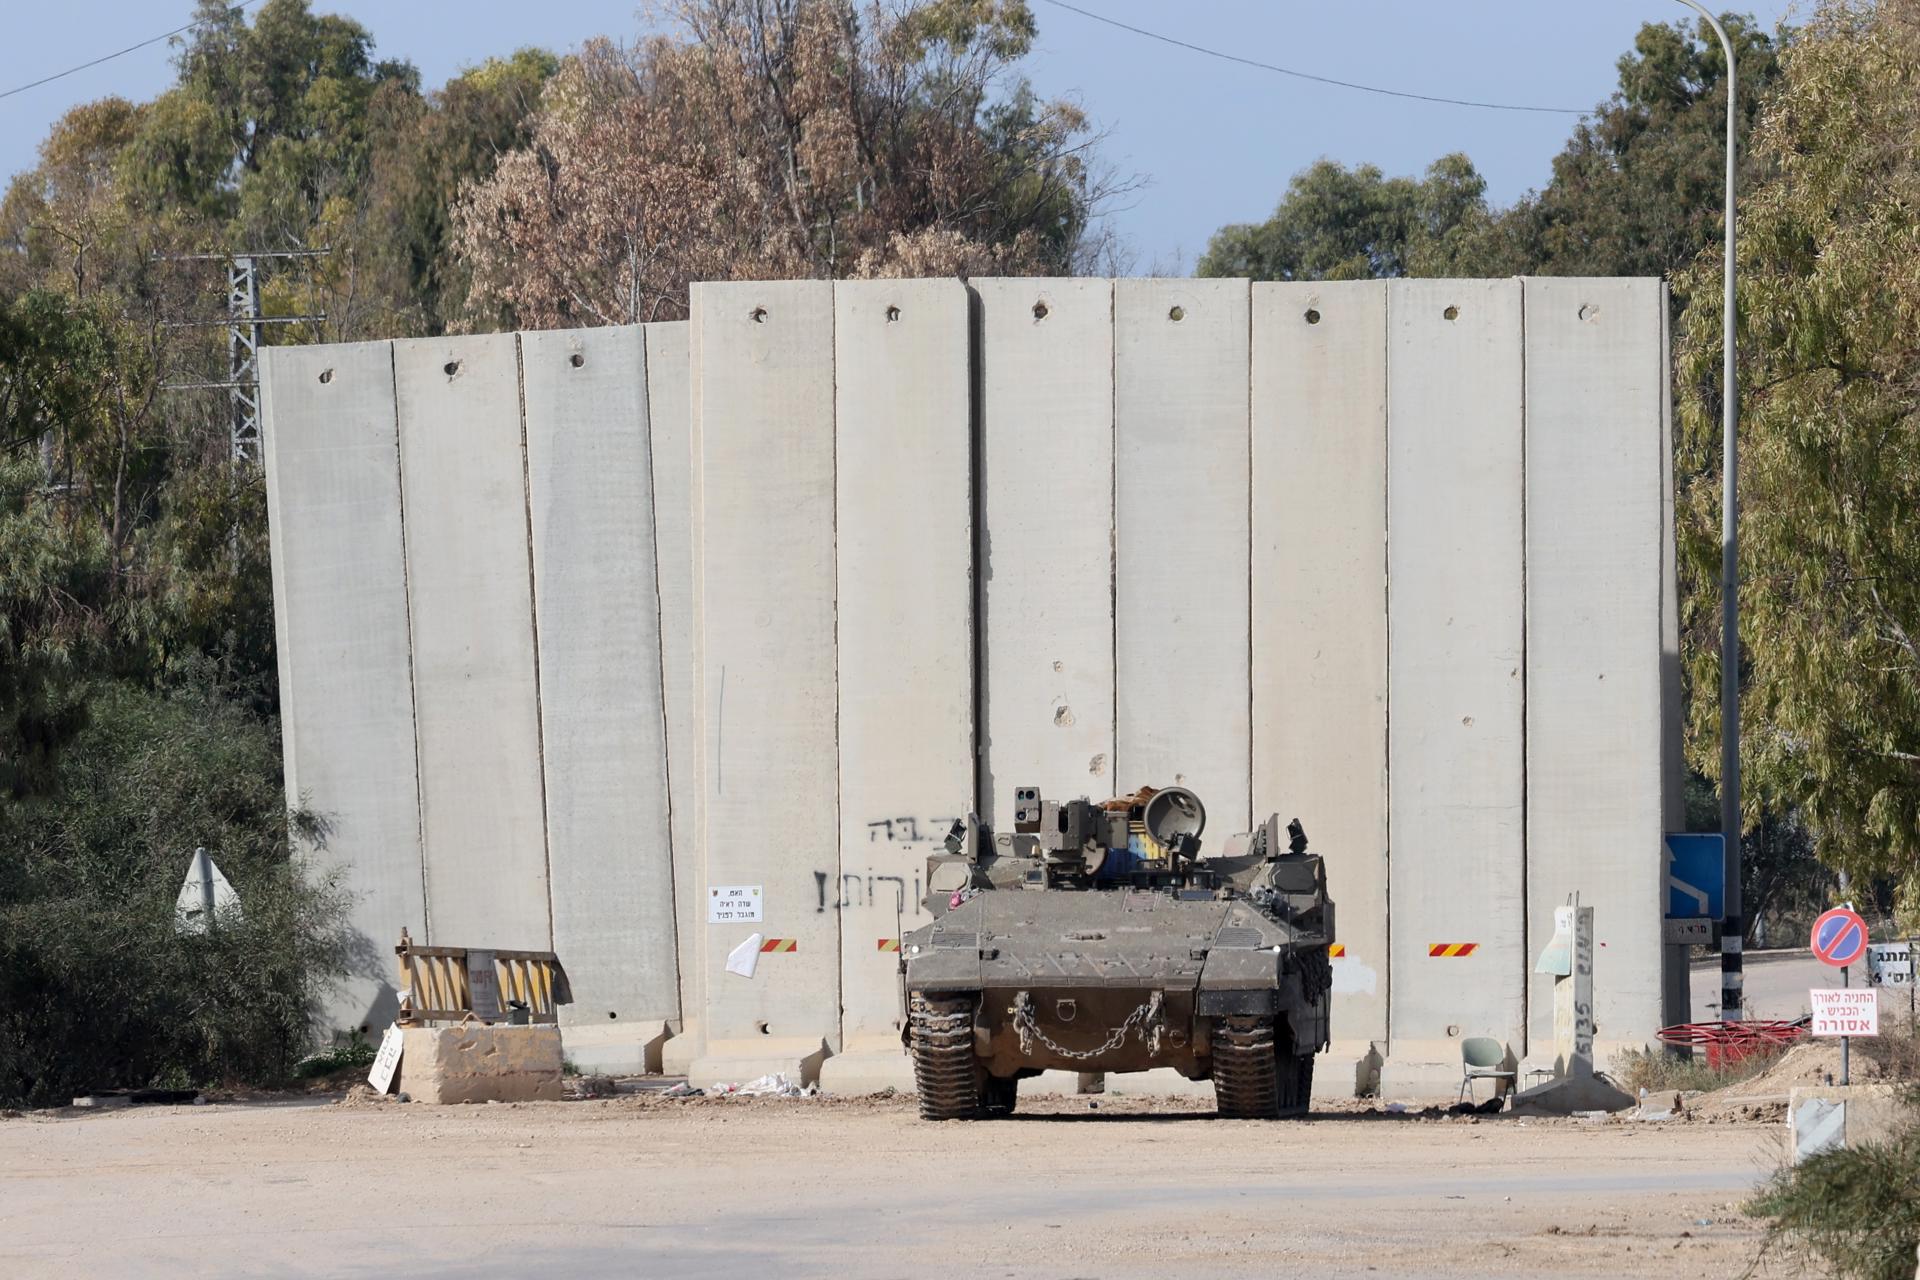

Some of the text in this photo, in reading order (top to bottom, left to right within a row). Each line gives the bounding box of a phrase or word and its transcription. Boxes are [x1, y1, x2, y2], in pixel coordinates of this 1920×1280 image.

[1873, 972, 1883, 984] 6
[1813, 992, 1874, 1006] החניה לאורך
[1827, 1006, 1859, 1017] הכביש
[1818, 1019, 1871, 1031] אסורה
